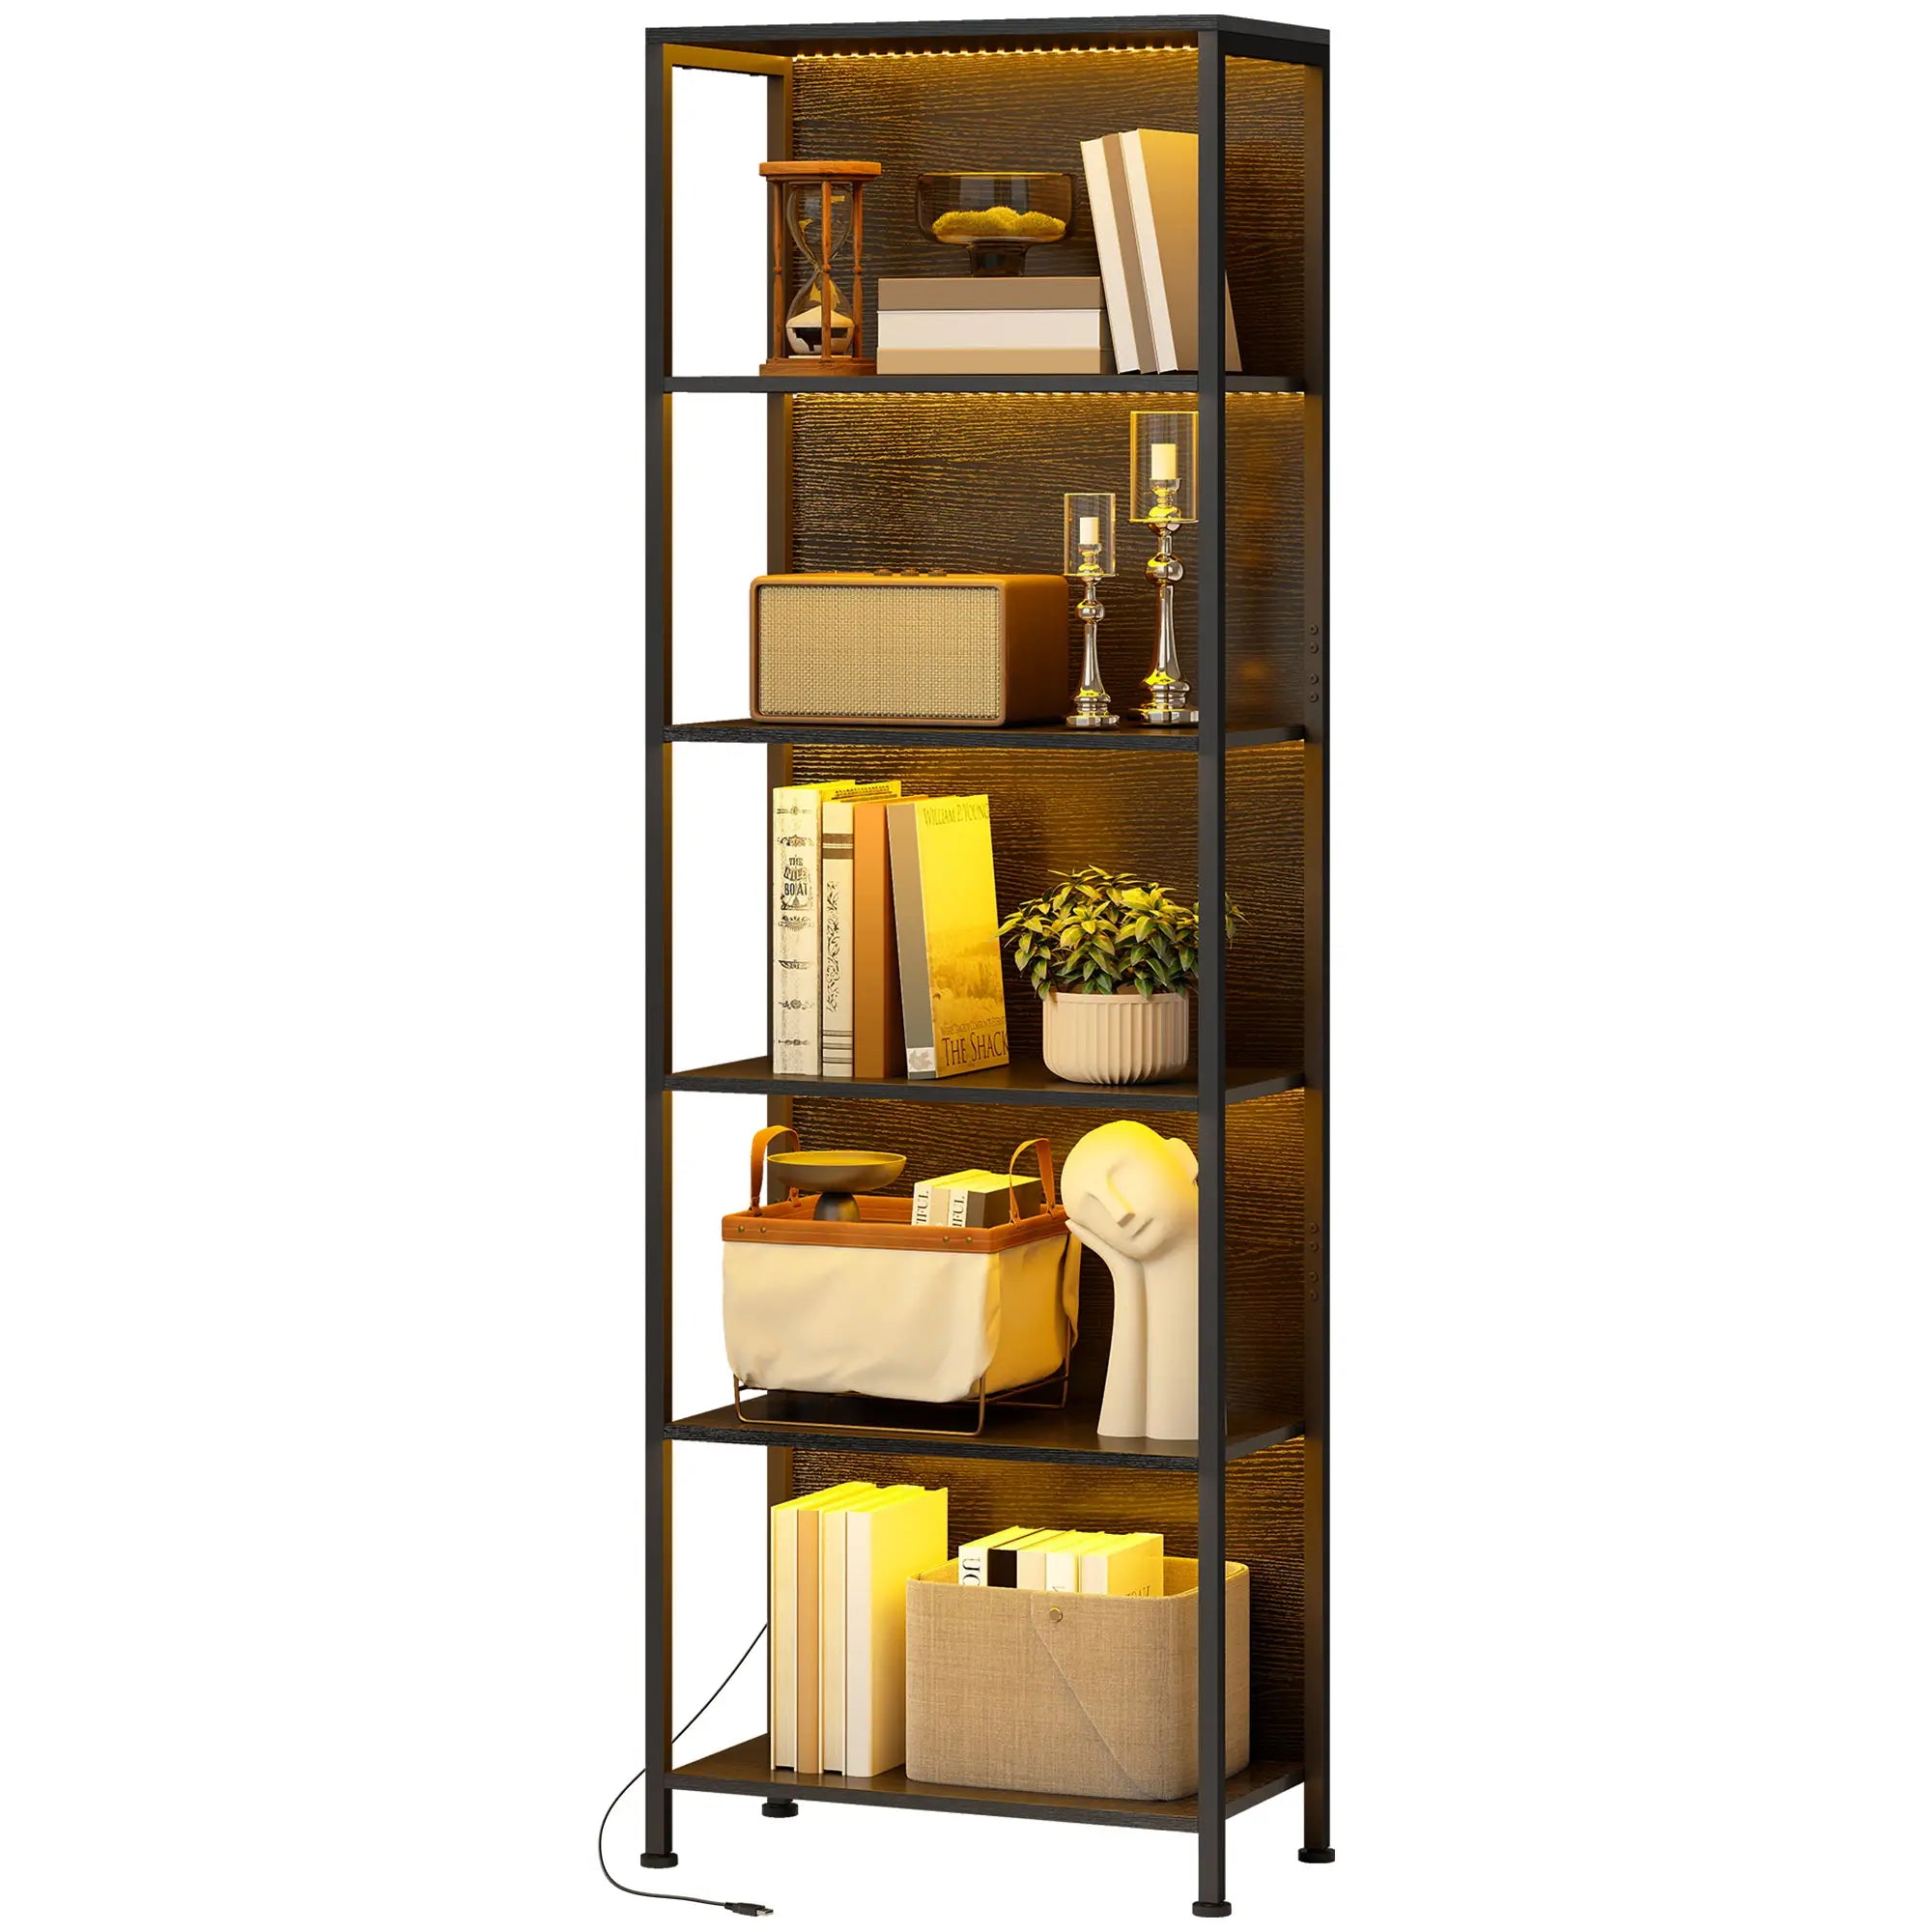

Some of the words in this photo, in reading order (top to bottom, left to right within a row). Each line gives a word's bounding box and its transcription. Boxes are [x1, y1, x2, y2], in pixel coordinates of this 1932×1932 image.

[923, 808, 956, 826] WILLIAM
[784, 883, 808, 895] BOAT
[942, 1037, 967, 1066] THE
[969, 1031, 1009, 1062] SHACK
